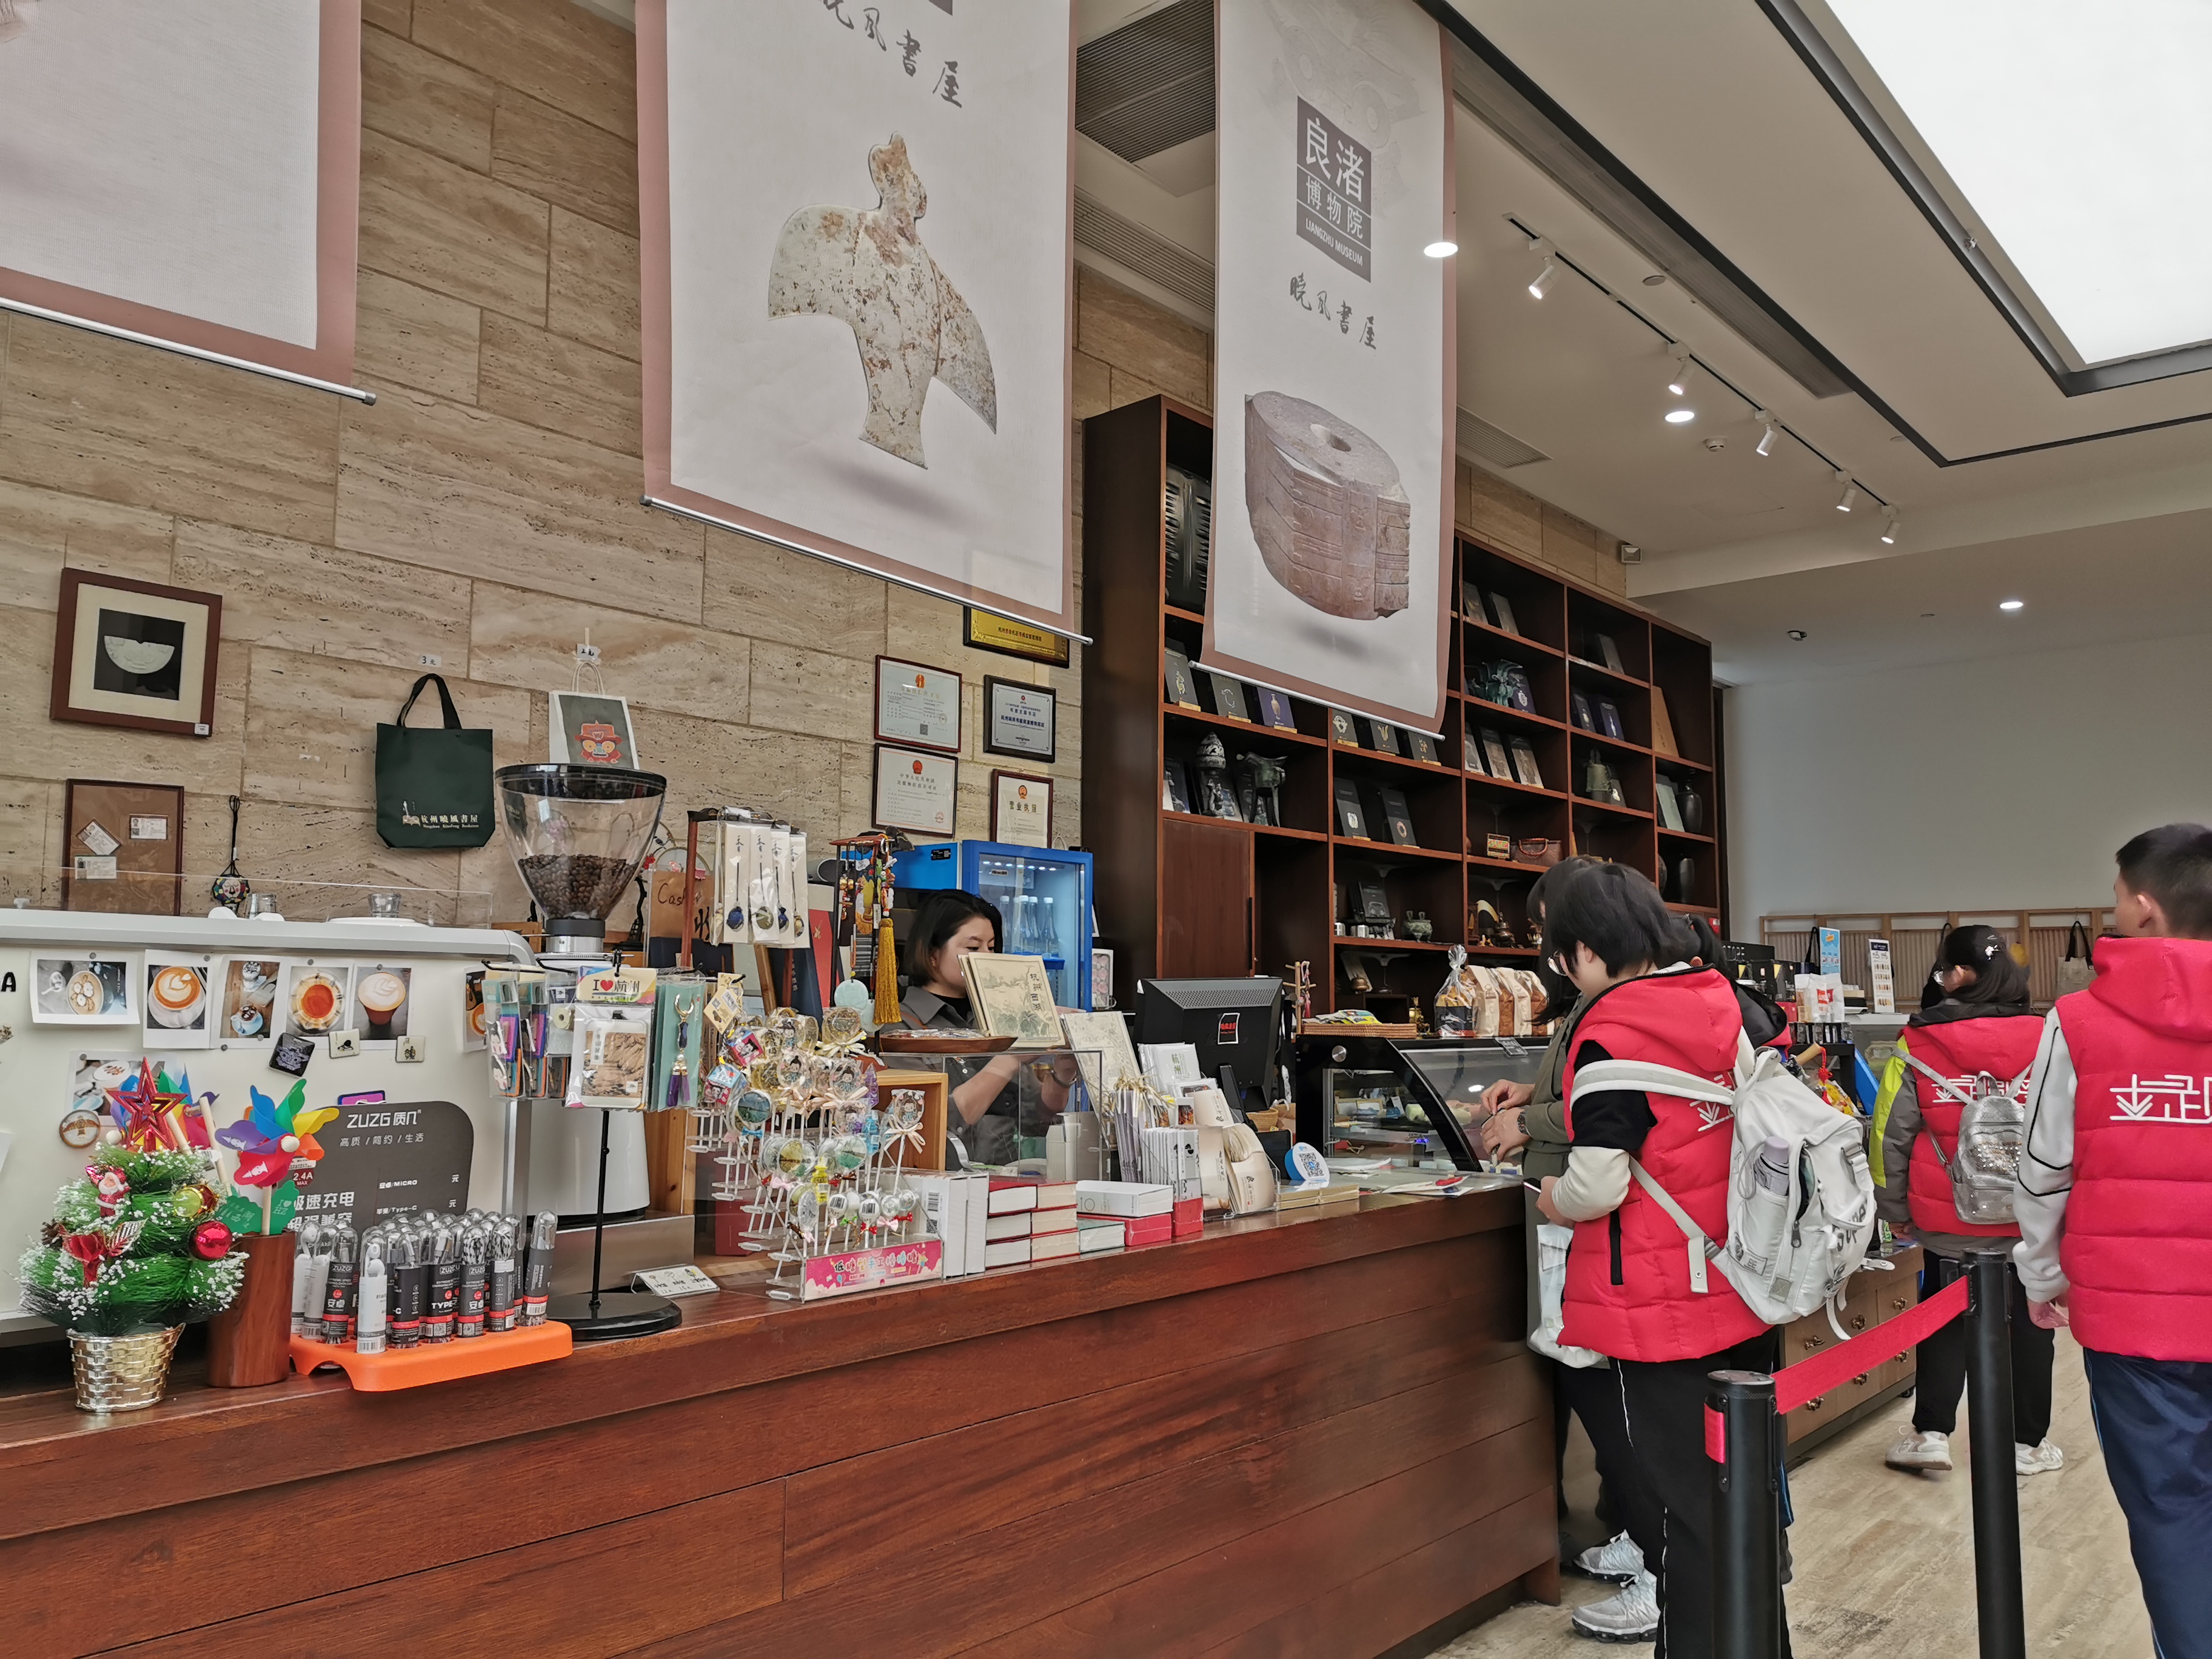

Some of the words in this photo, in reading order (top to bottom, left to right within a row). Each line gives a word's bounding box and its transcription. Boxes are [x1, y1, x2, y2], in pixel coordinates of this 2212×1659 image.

[1305, 118, 1364, 203] 良渚
[1306, 175, 1363, 240] 博物院
[1305, 217, 1334, 248] LIANGZHU
[1335, 241, 1363, 267] MUSEUM
[346, 1113, 392, 1129] ZUZG
[340, 1136, 361, 1147] 高质
[372, 1134, 393, 1145] 简约
[404, 1132, 424, 1143] 生活
[293, 1171, 313, 1181] 2.4A
[451, 1174, 460, 1183] 元
[449, 1199, 457, 1208] 元
